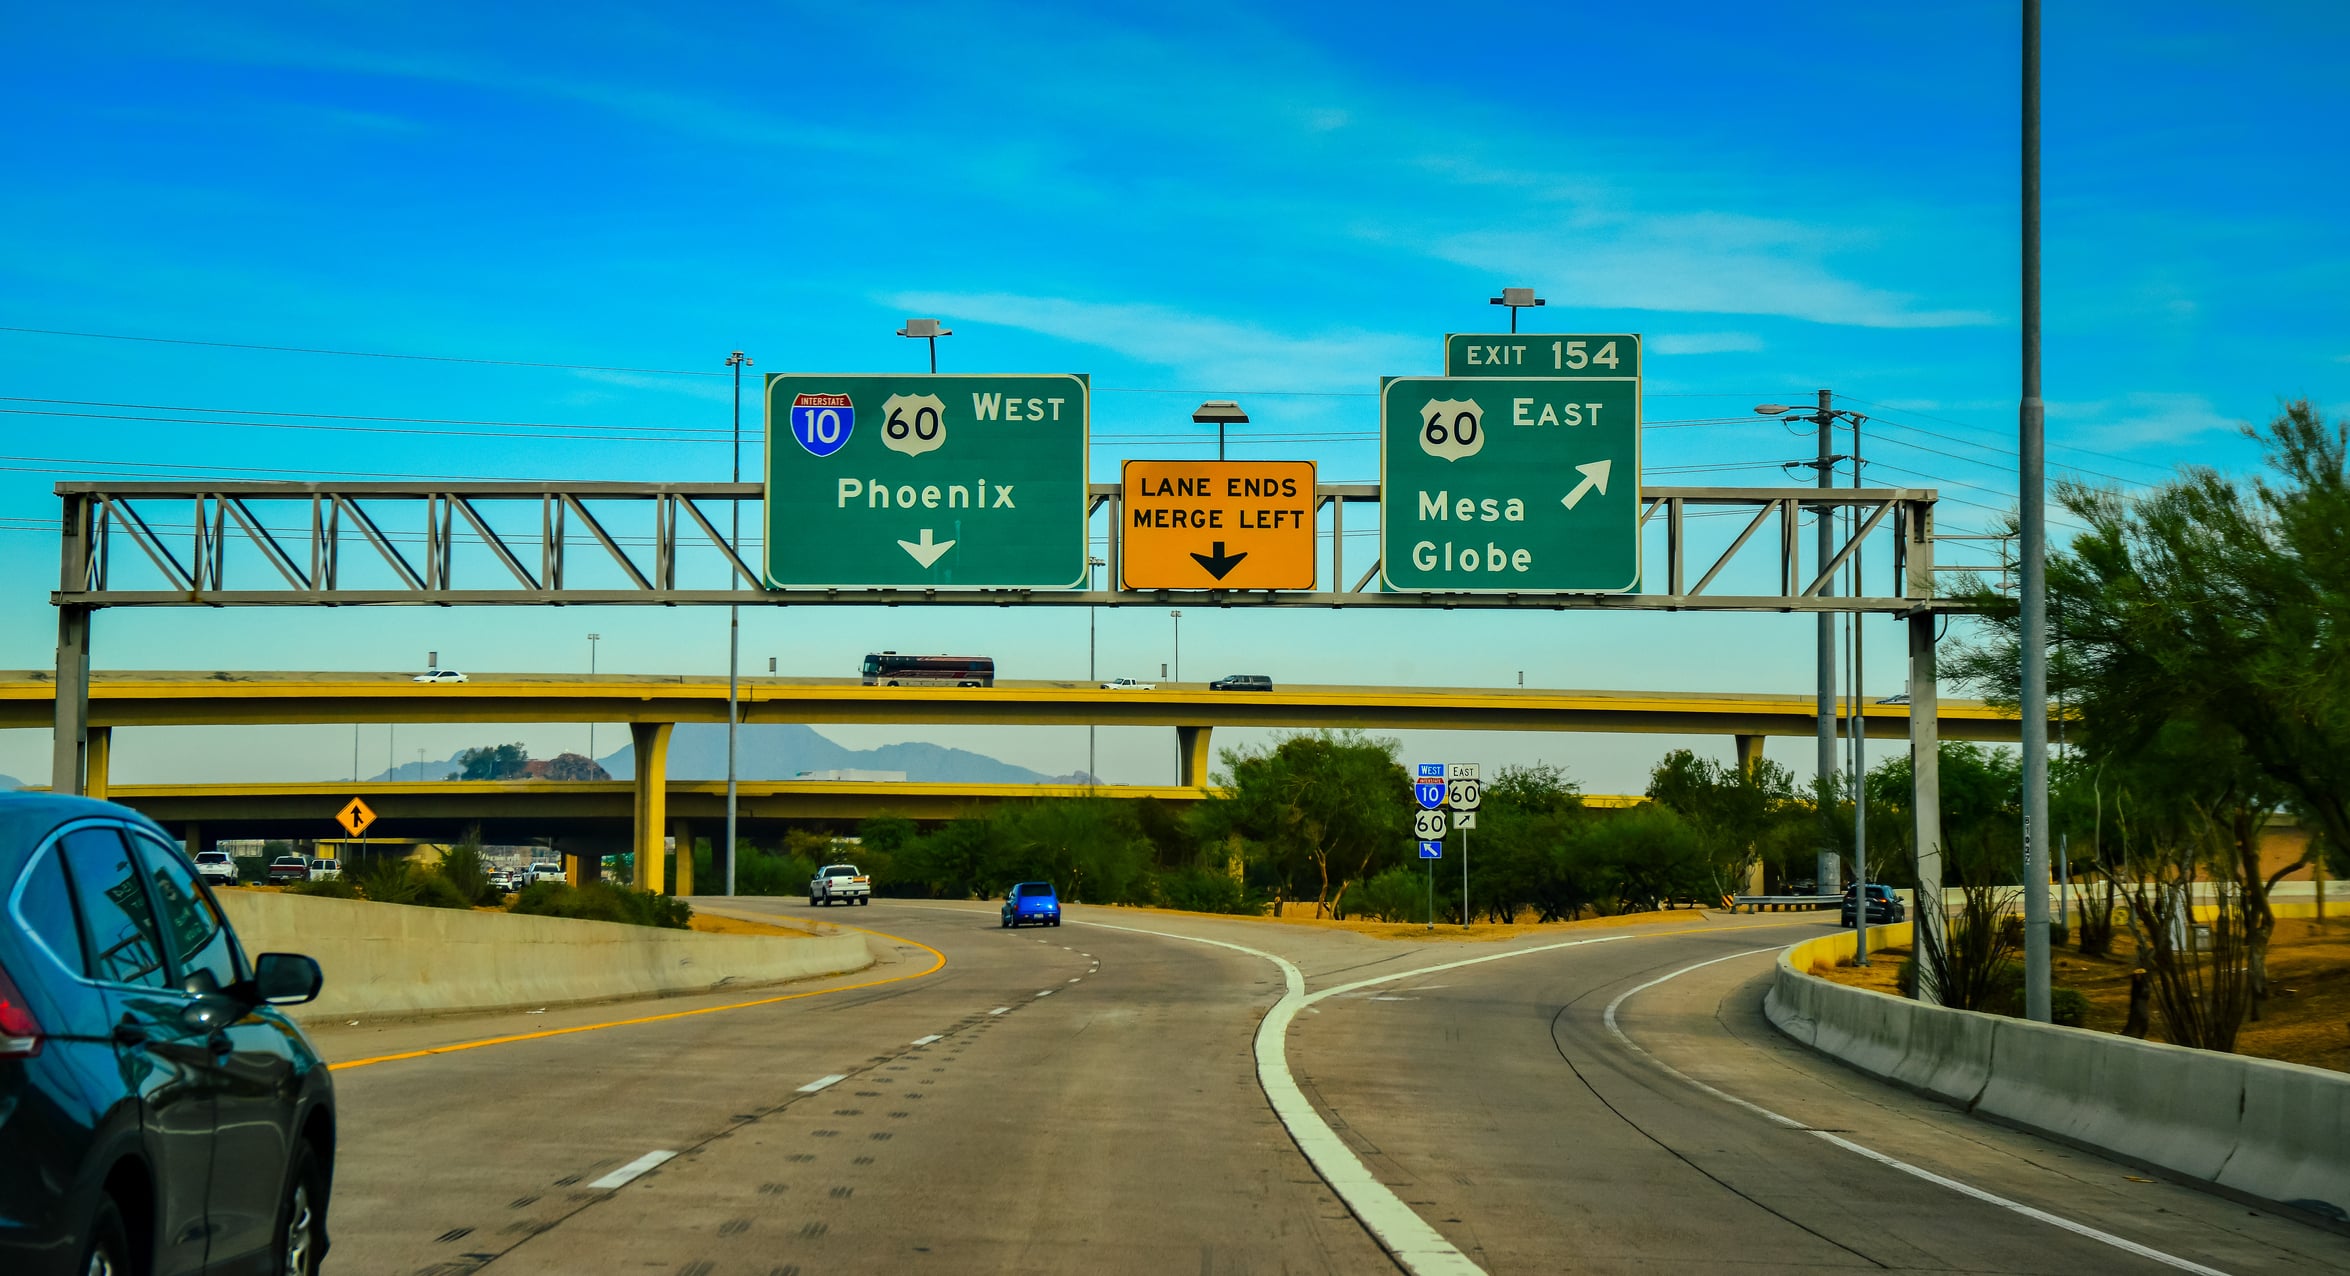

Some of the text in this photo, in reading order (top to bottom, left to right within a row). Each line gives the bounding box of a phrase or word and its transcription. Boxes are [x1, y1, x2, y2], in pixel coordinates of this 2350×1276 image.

[1467, 341, 1619, 370] EXIT 154
[800, 397, 845, 406] INTERSTATE
[972, 392, 1065, 421] WEST
[1513, 397, 1603, 426] EAST
[805, 408, 841, 444] 10
[886, 406, 939, 441] 60
[1425, 411, 1477, 446] 60
[838, 477, 1016, 509] Phoenix
[1141, 477, 1297, 498] LANE ENDS
[1133, 508, 1305, 529] MERGE LEFT
[1418, 490, 1525, 522] Mesa
[1412, 540, 1532, 573] Globe
[1421, 766, 1441, 775] WEST
[1453, 767, 1474, 777] EAST
[1422, 787, 1439, 802] 10
[1450, 785, 1477, 803] 60
[1417, 815, 1443, 832] 60
